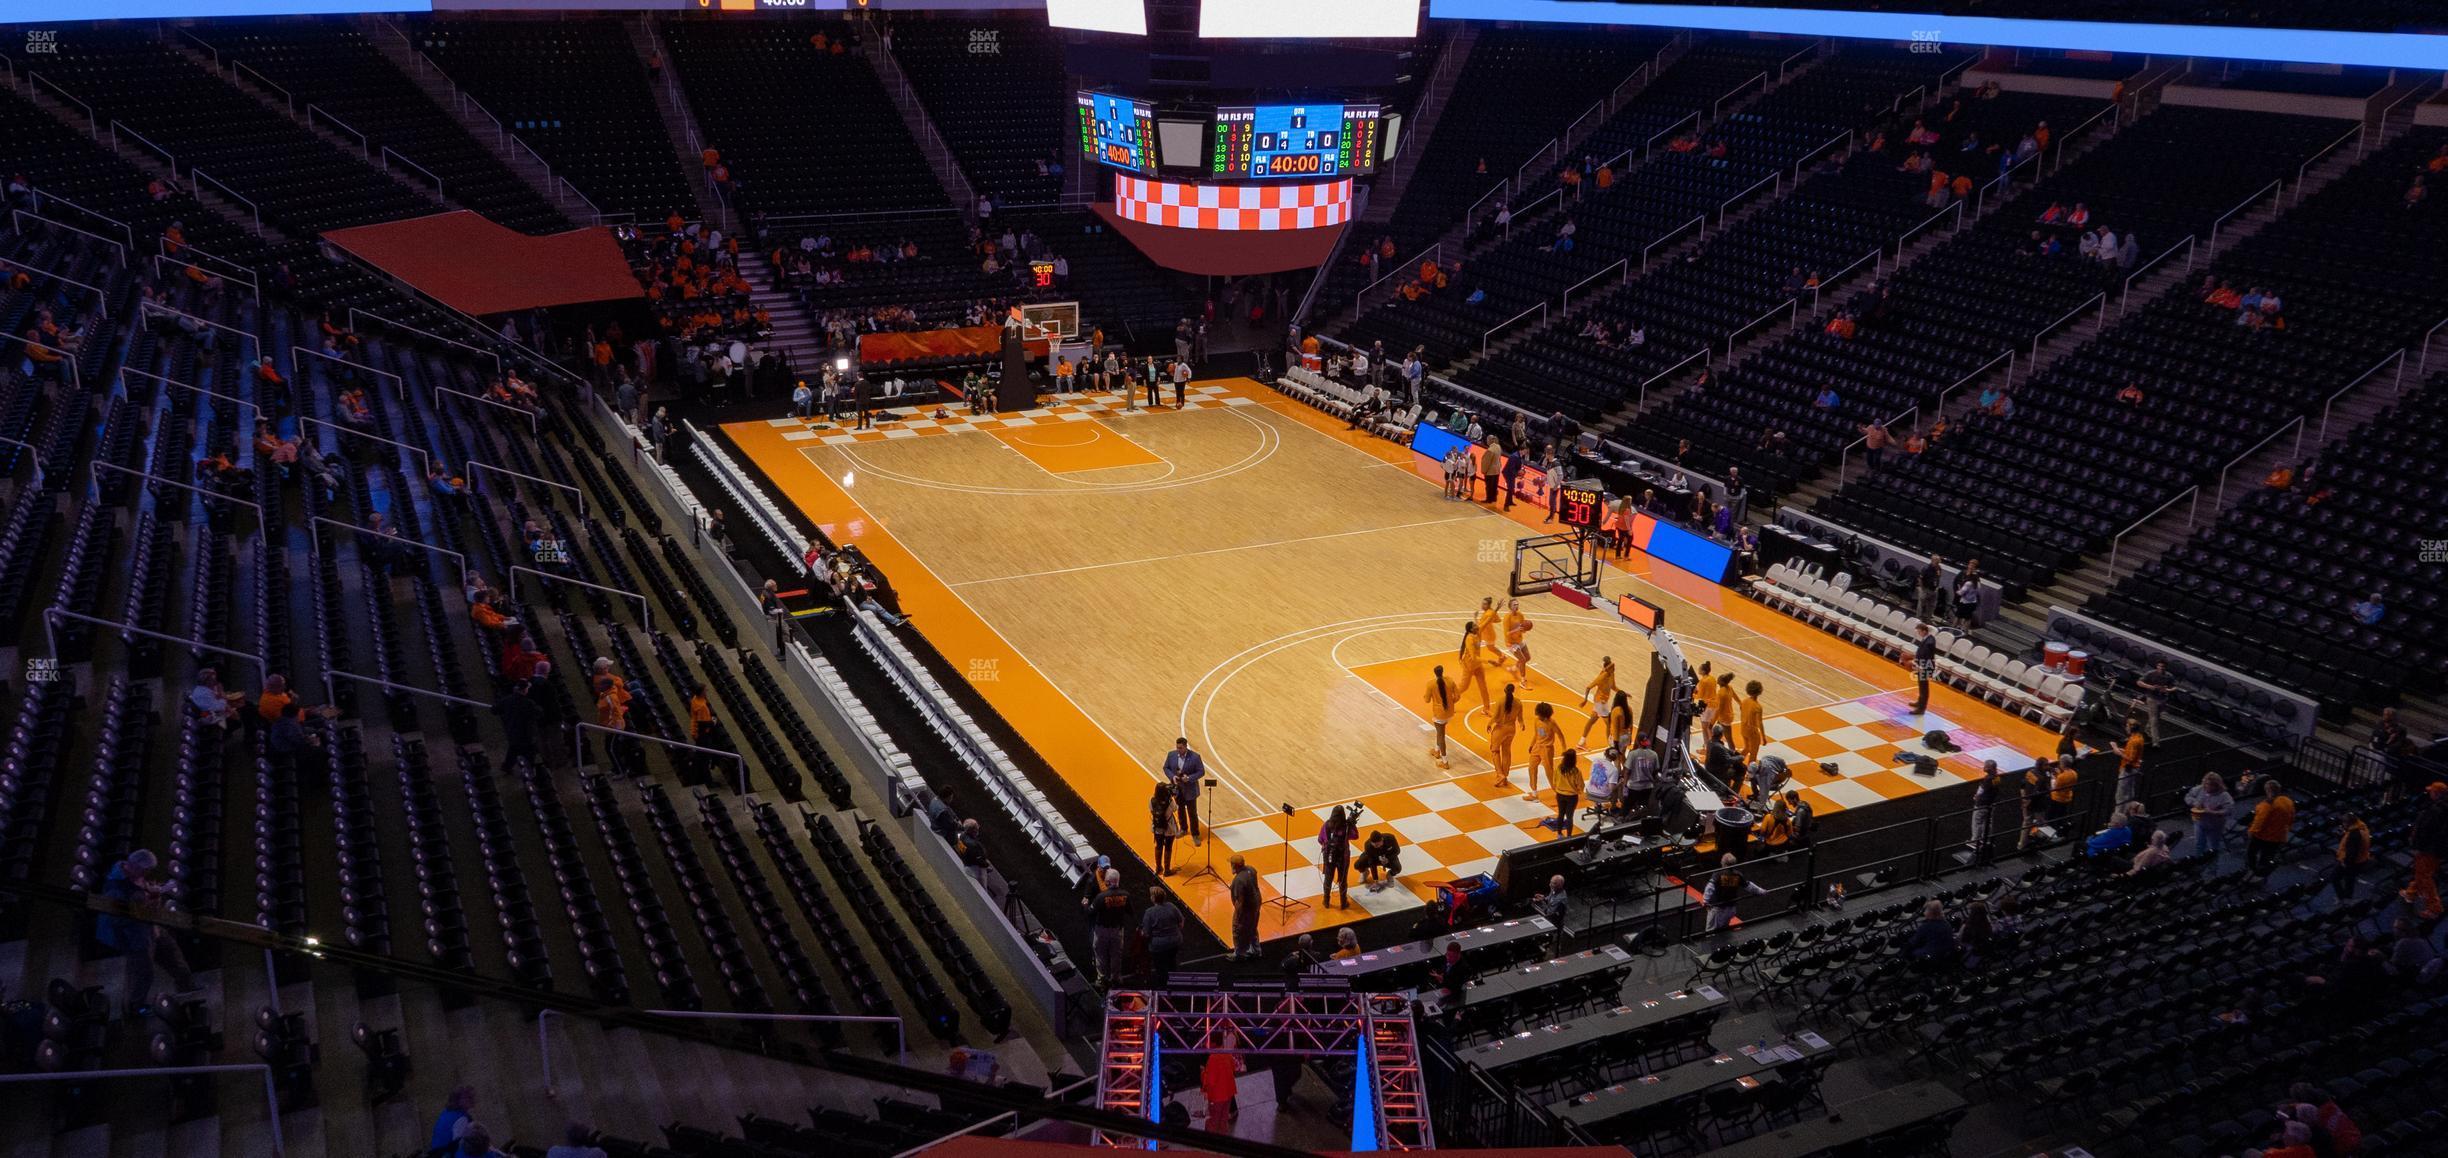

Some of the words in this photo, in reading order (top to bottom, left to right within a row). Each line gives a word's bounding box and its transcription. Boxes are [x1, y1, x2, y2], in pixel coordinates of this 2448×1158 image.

[1230, 113, 1242, 121] FLS
[1243, 113, 1254, 121] PTS
[1241, 134, 1252, 142] 17
[1341, 141, 1351, 149] 20
[1108, 145, 1130, 165] 40:00
[1215, 154, 1225, 162] 23
[1240, 153, 1250, 161] 10
[1214, 164, 1224, 172] 33
[1270, 155, 1318, 172] 40:00
[1339, 160, 1349, 168] 24
[1036, 273, 1050, 286] 30
[1563, 490, 1596, 505] 40:00
[1568, 502, 1590, 524] 30
